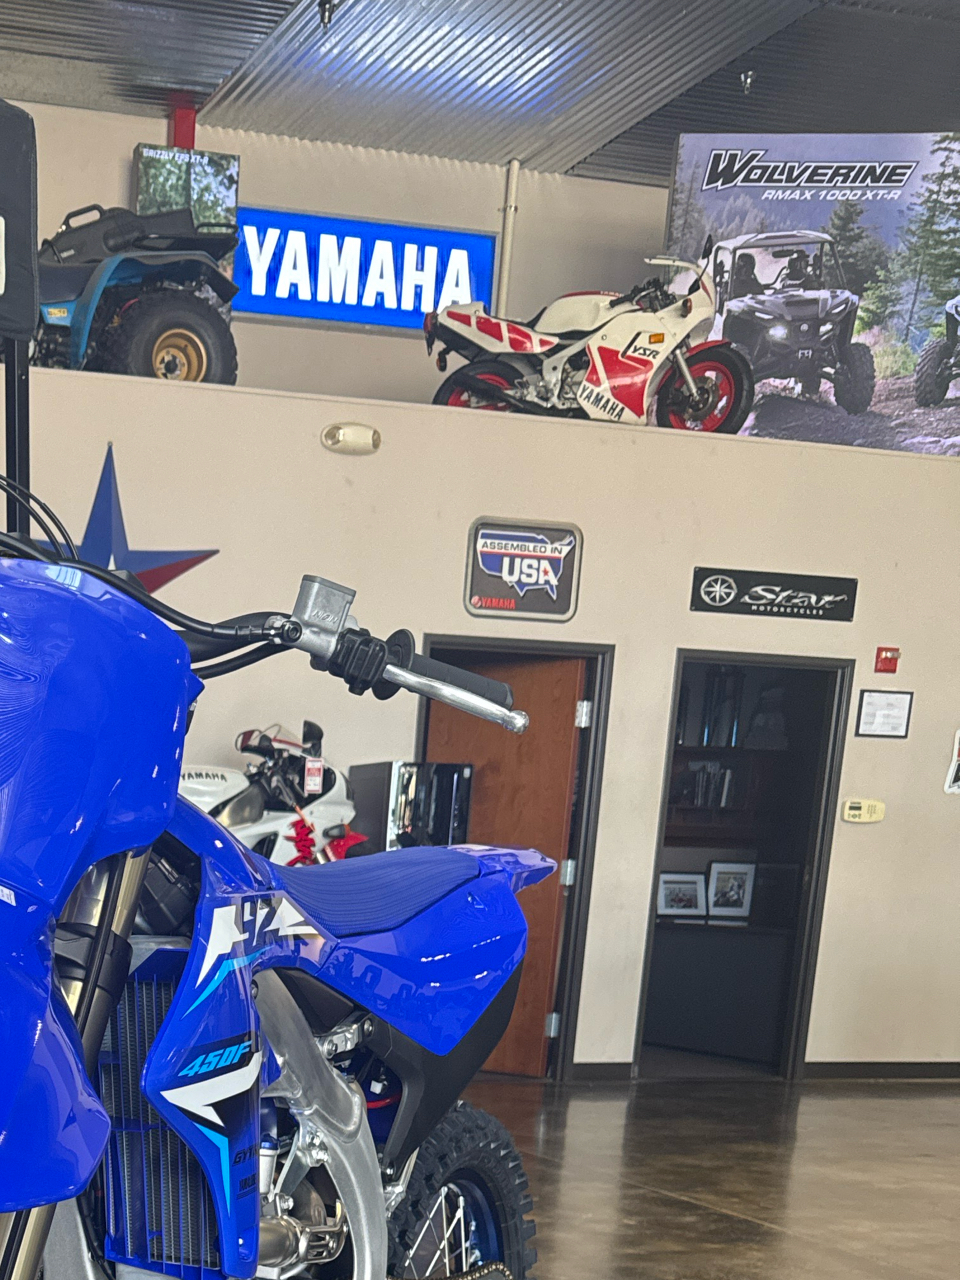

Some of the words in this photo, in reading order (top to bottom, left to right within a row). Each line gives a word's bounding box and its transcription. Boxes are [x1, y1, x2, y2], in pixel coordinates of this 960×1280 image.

[143, 148, 173, 160] GRIZZLY
[175, 153, 189, 163] EPS
[761, 189, 814, 200] RMAX
[818, 189, 862, 200] 1000
[243, 225, 472, 315] YAMAHA
[632, 345, 660, 359] YSR
[580, 384, 625, 420] YAMAHA
[481, 540, 547, 554] ASSEMBLED
[550, 546, 562, 554] IN
[502, 557, 559, 585] USA
[482, 597, 516, 609] YAMAHA
[751, 605, 824, 616] MOTORCYCLES
[180, 772, 227, 782] YAMAHA
[178, 1040, 253, 1077] 450F
